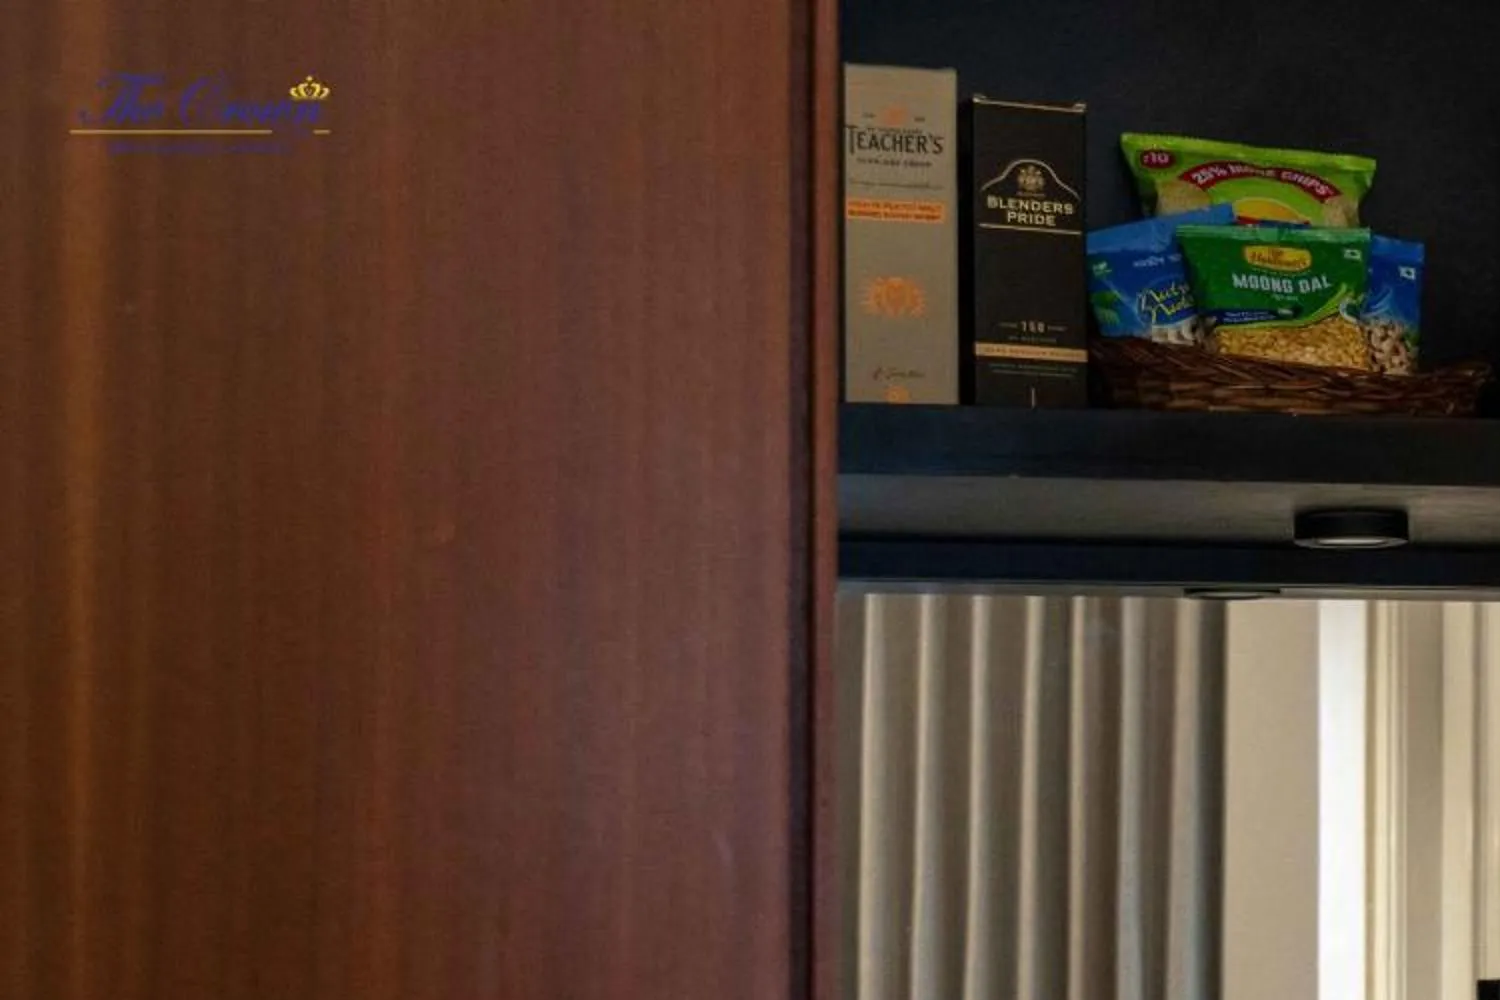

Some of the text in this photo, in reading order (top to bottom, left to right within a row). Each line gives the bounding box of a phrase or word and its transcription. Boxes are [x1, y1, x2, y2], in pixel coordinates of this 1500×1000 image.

[845, 124, 945, 156] TEACHER'S
[986, 193, 1075, 216] BLENDERS
[1006, 210, 1058, 228] PRIDE
[1231, 272, 1333, 295] MOONG DAL
